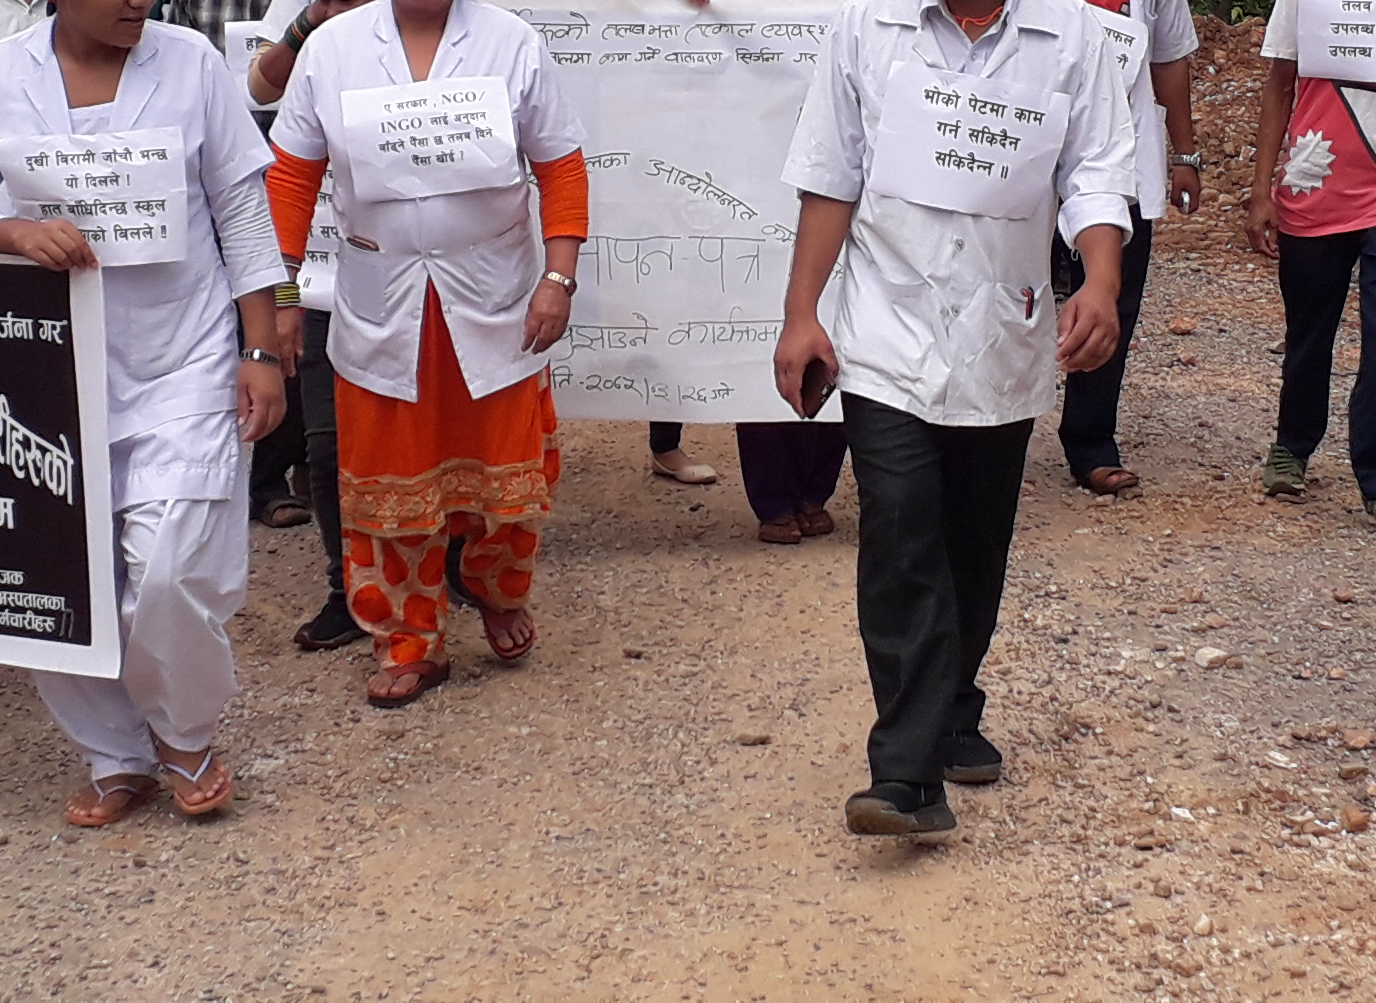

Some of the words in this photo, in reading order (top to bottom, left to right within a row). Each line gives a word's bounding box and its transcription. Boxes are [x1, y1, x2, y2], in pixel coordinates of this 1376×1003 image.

[968, 93, 1008, 119] पेटमा
[1013, 106, 1046, 127] काम
[380, 116, 423, 134] INGO
[936, 118, 962, 140] गर्न
[64, 174, 79, 189] यो
[85, 172, 121, 189] दिलले
[38, 203, 62, 217] हात
[133, 199, 167, 217] स्कुल
